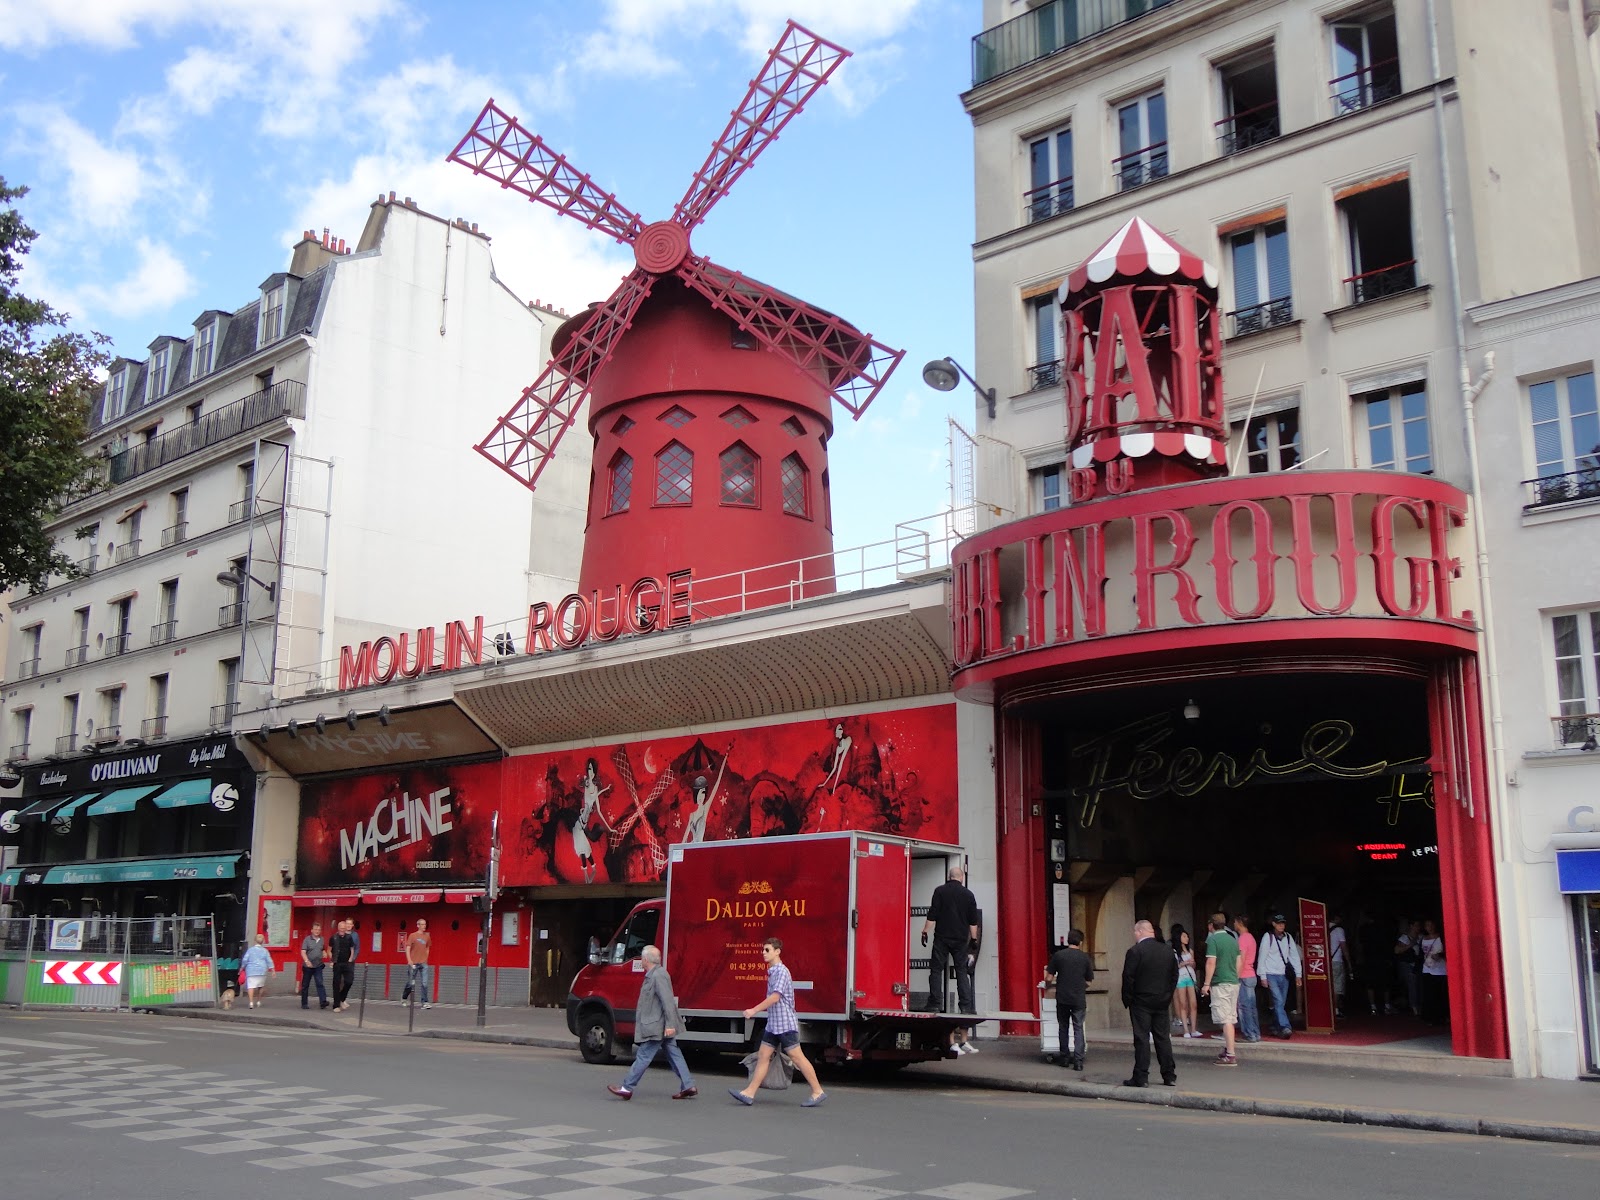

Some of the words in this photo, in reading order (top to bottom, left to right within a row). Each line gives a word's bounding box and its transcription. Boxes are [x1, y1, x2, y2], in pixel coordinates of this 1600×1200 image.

[952, 523, 1109, 669] ULIN
[1131, 493, 1476, 631] ROUGE
[339, 616, 484, 691] MOULIN
[526, 568, 696, 655] ROUGE
[91, 754, 161, 781] O'SULLIVANS
[340, 786, 453, 870] MACHINE
[706, 898, 806, 921] DALLOYAU
